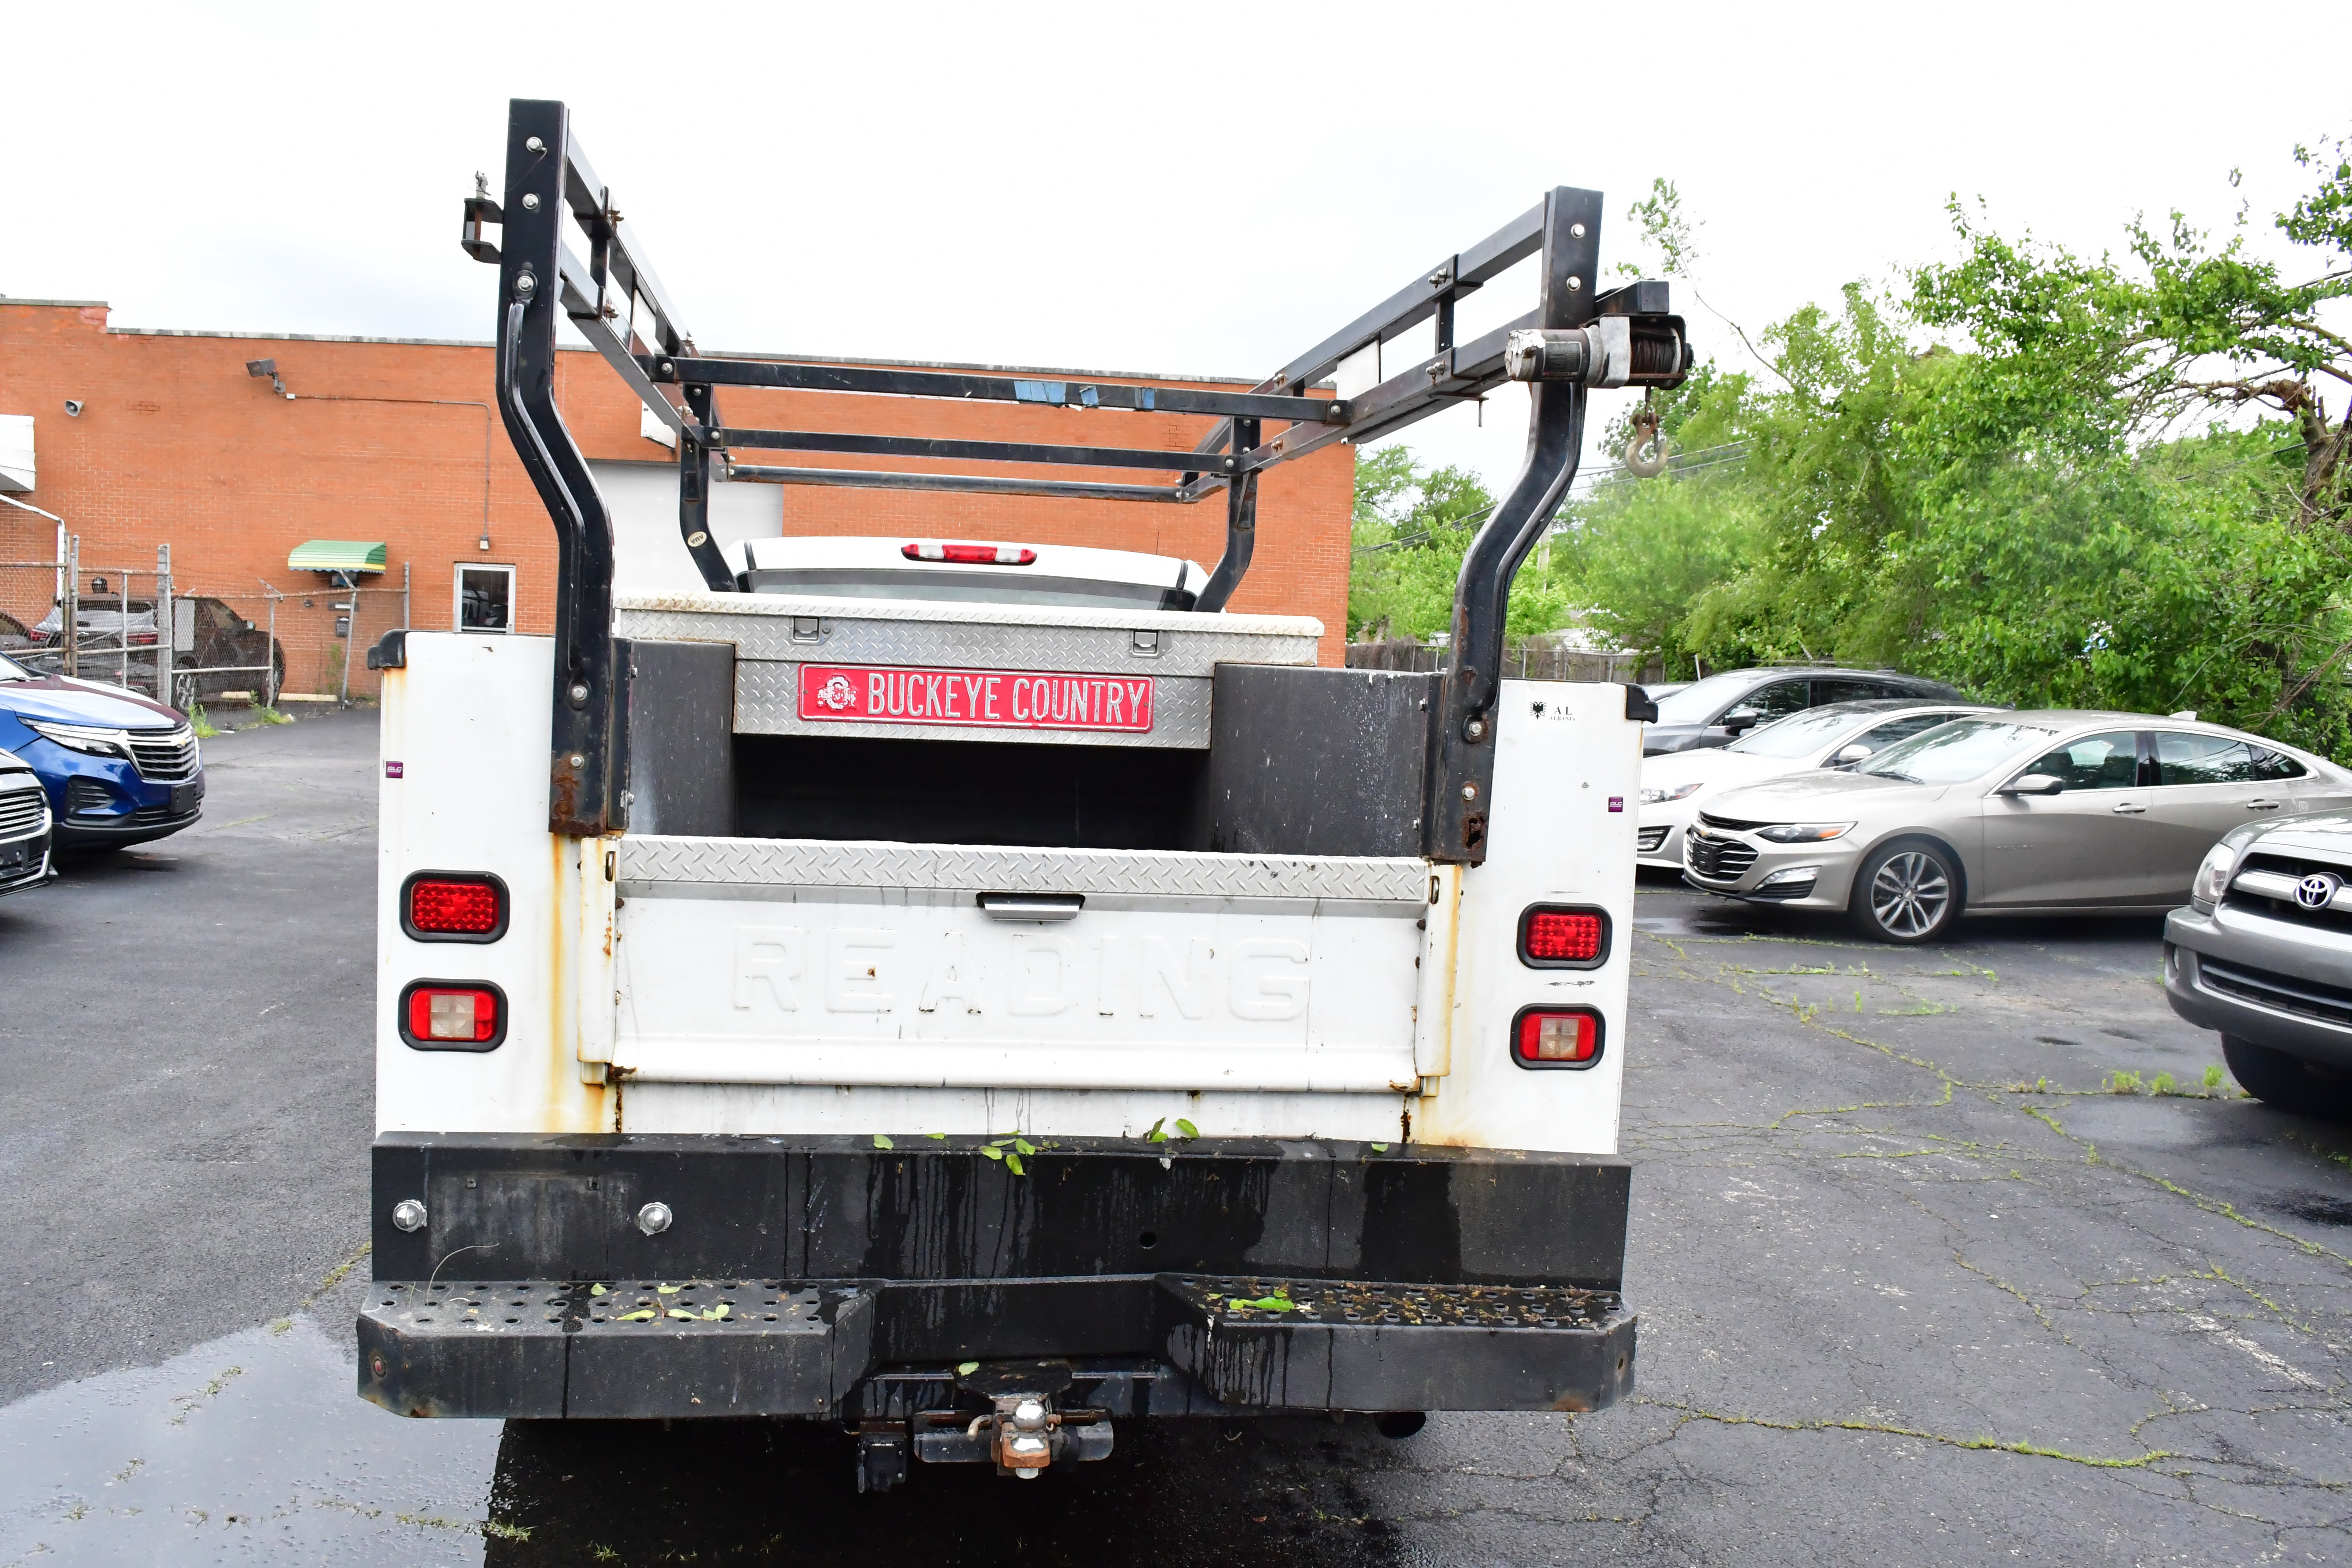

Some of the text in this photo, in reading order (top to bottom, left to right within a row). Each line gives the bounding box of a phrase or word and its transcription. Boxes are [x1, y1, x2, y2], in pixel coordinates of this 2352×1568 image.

[868, 673, 1000, 719] BUCKEYE
[1013, 678, 1146, 724] COUNTRY
[734, 925, 1311, 1021] READING
